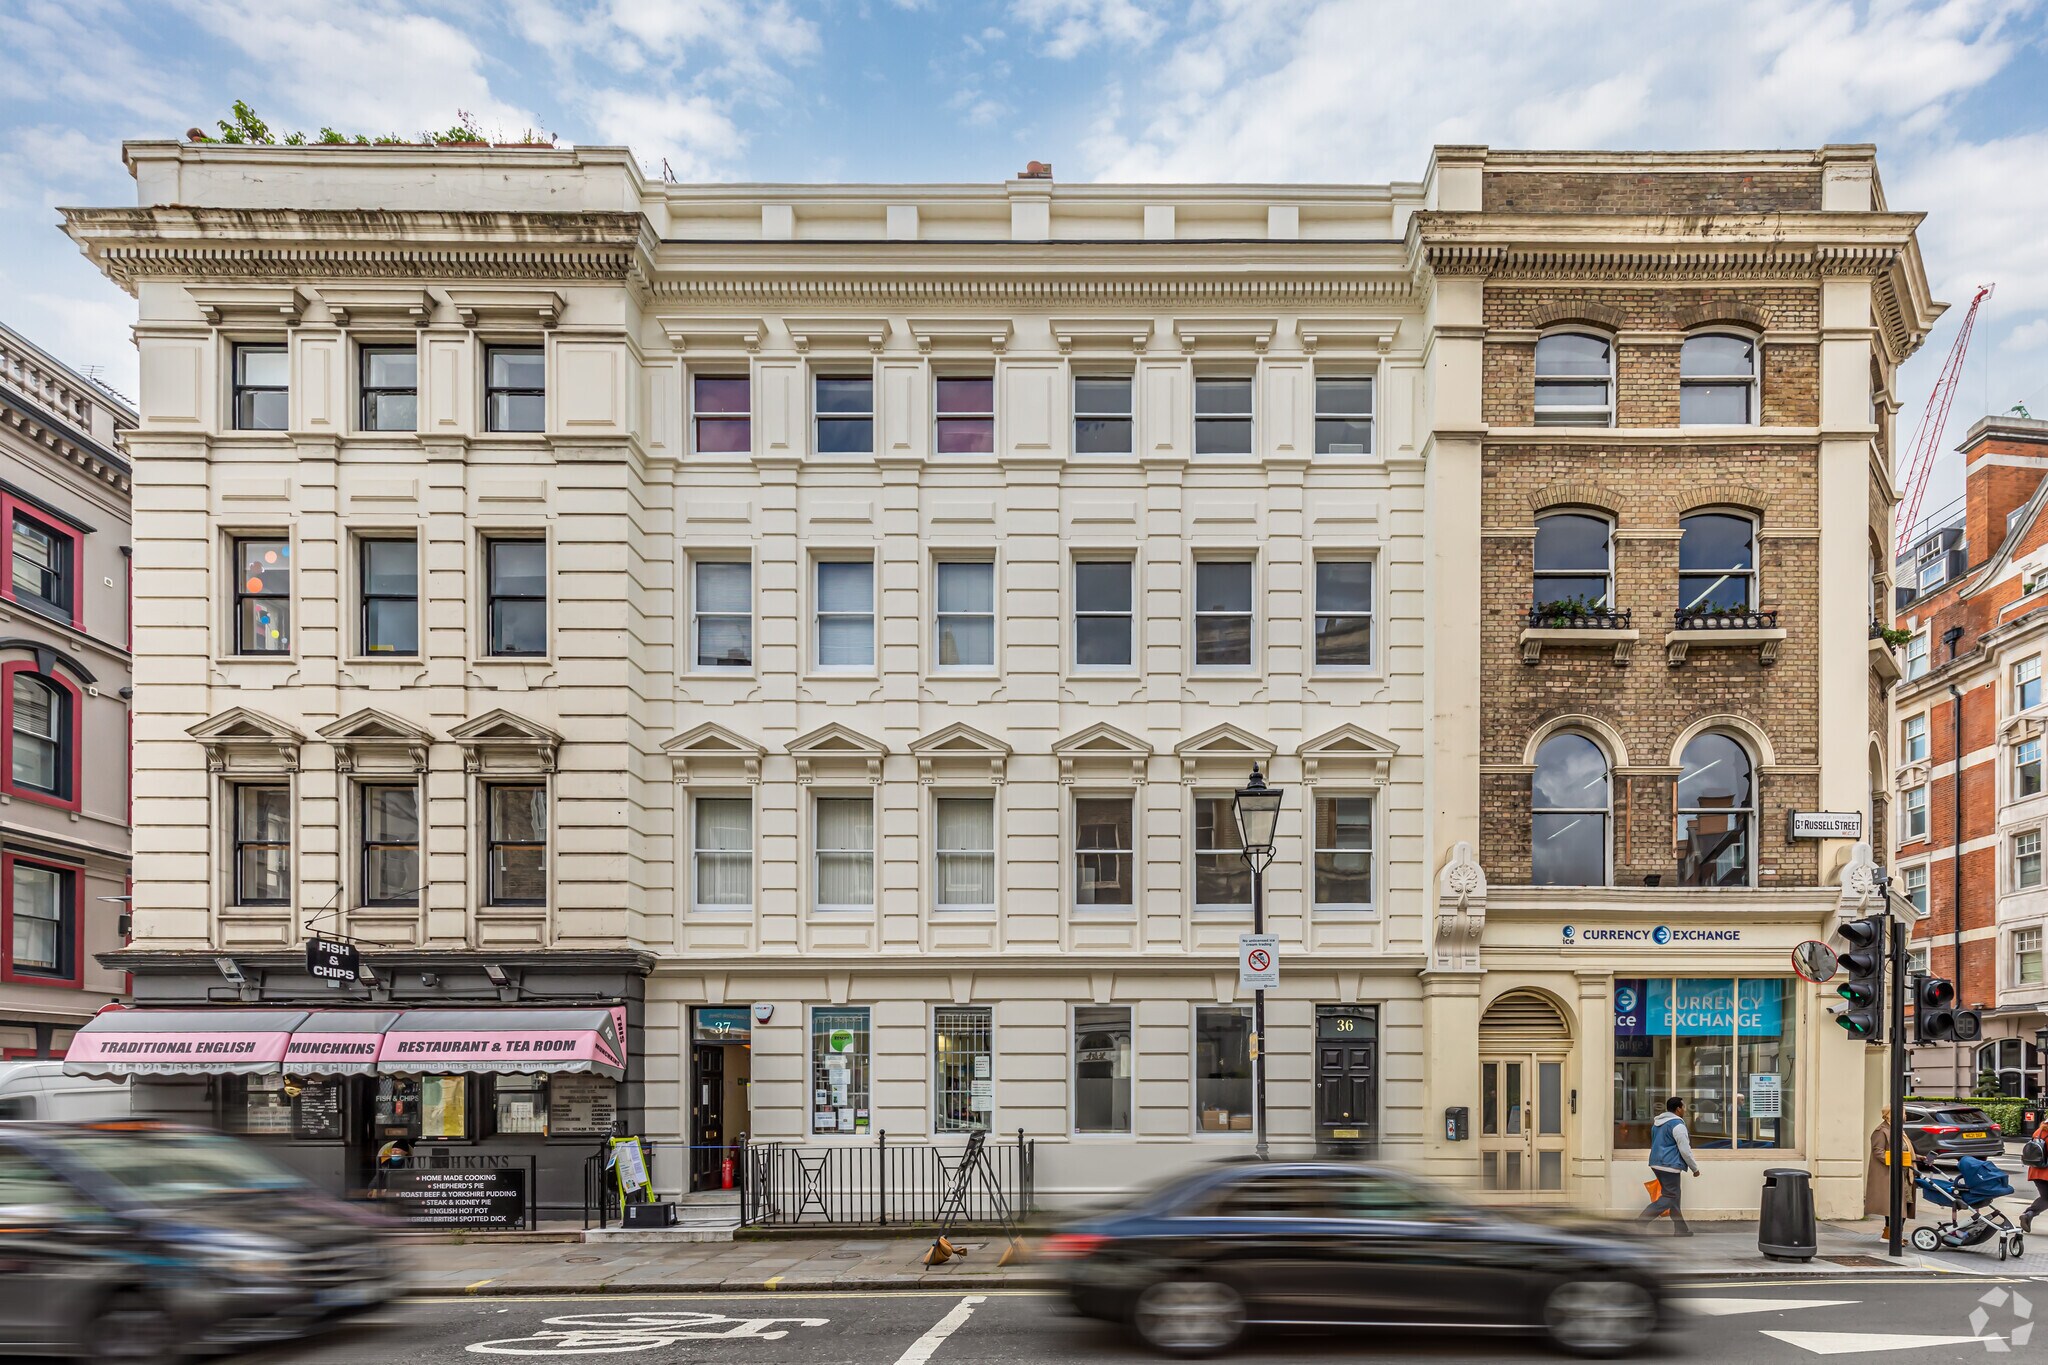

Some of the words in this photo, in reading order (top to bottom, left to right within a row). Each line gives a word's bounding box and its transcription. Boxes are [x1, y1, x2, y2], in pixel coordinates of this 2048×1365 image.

[1804, 820, 1834, 830] RUSSELL
[1834, 820, 1860, 830] STREET
[1583, 930, 1650, 940] CURRENCY
[1673, 930, 1740, 940] EXCHANGE
[319, 942, 350, 956] FISH
[329, 956, 339, 966] &
[314, 966, 354, 980] CHIPS
[1664, 996, 1762, 1010] CURRENCY
[1336, 1020, 1354, 1032] 36
[1664, 1014, 1762, 1027] EXCHANGE
[715, 1022, 731, 1034] 37
[101, 1042, 192, 1053] TRADITIONAL
[195, 1042, 256, 1053] ENGLISH
[288, 1042, 375, 1054] MUNCHKINS
[398, 1041, 490, 1053] RESTAURANT
[491, 1042, 502, 1052] &
[506, 1041, 530, 1052] TEA
[533, 1040, 576, 1051] ROOM
[283, 1063, 312, 1073] FISH
[316, 1064, 325, 1072] &
[328, 1063, 368, 1073] CHIPS
